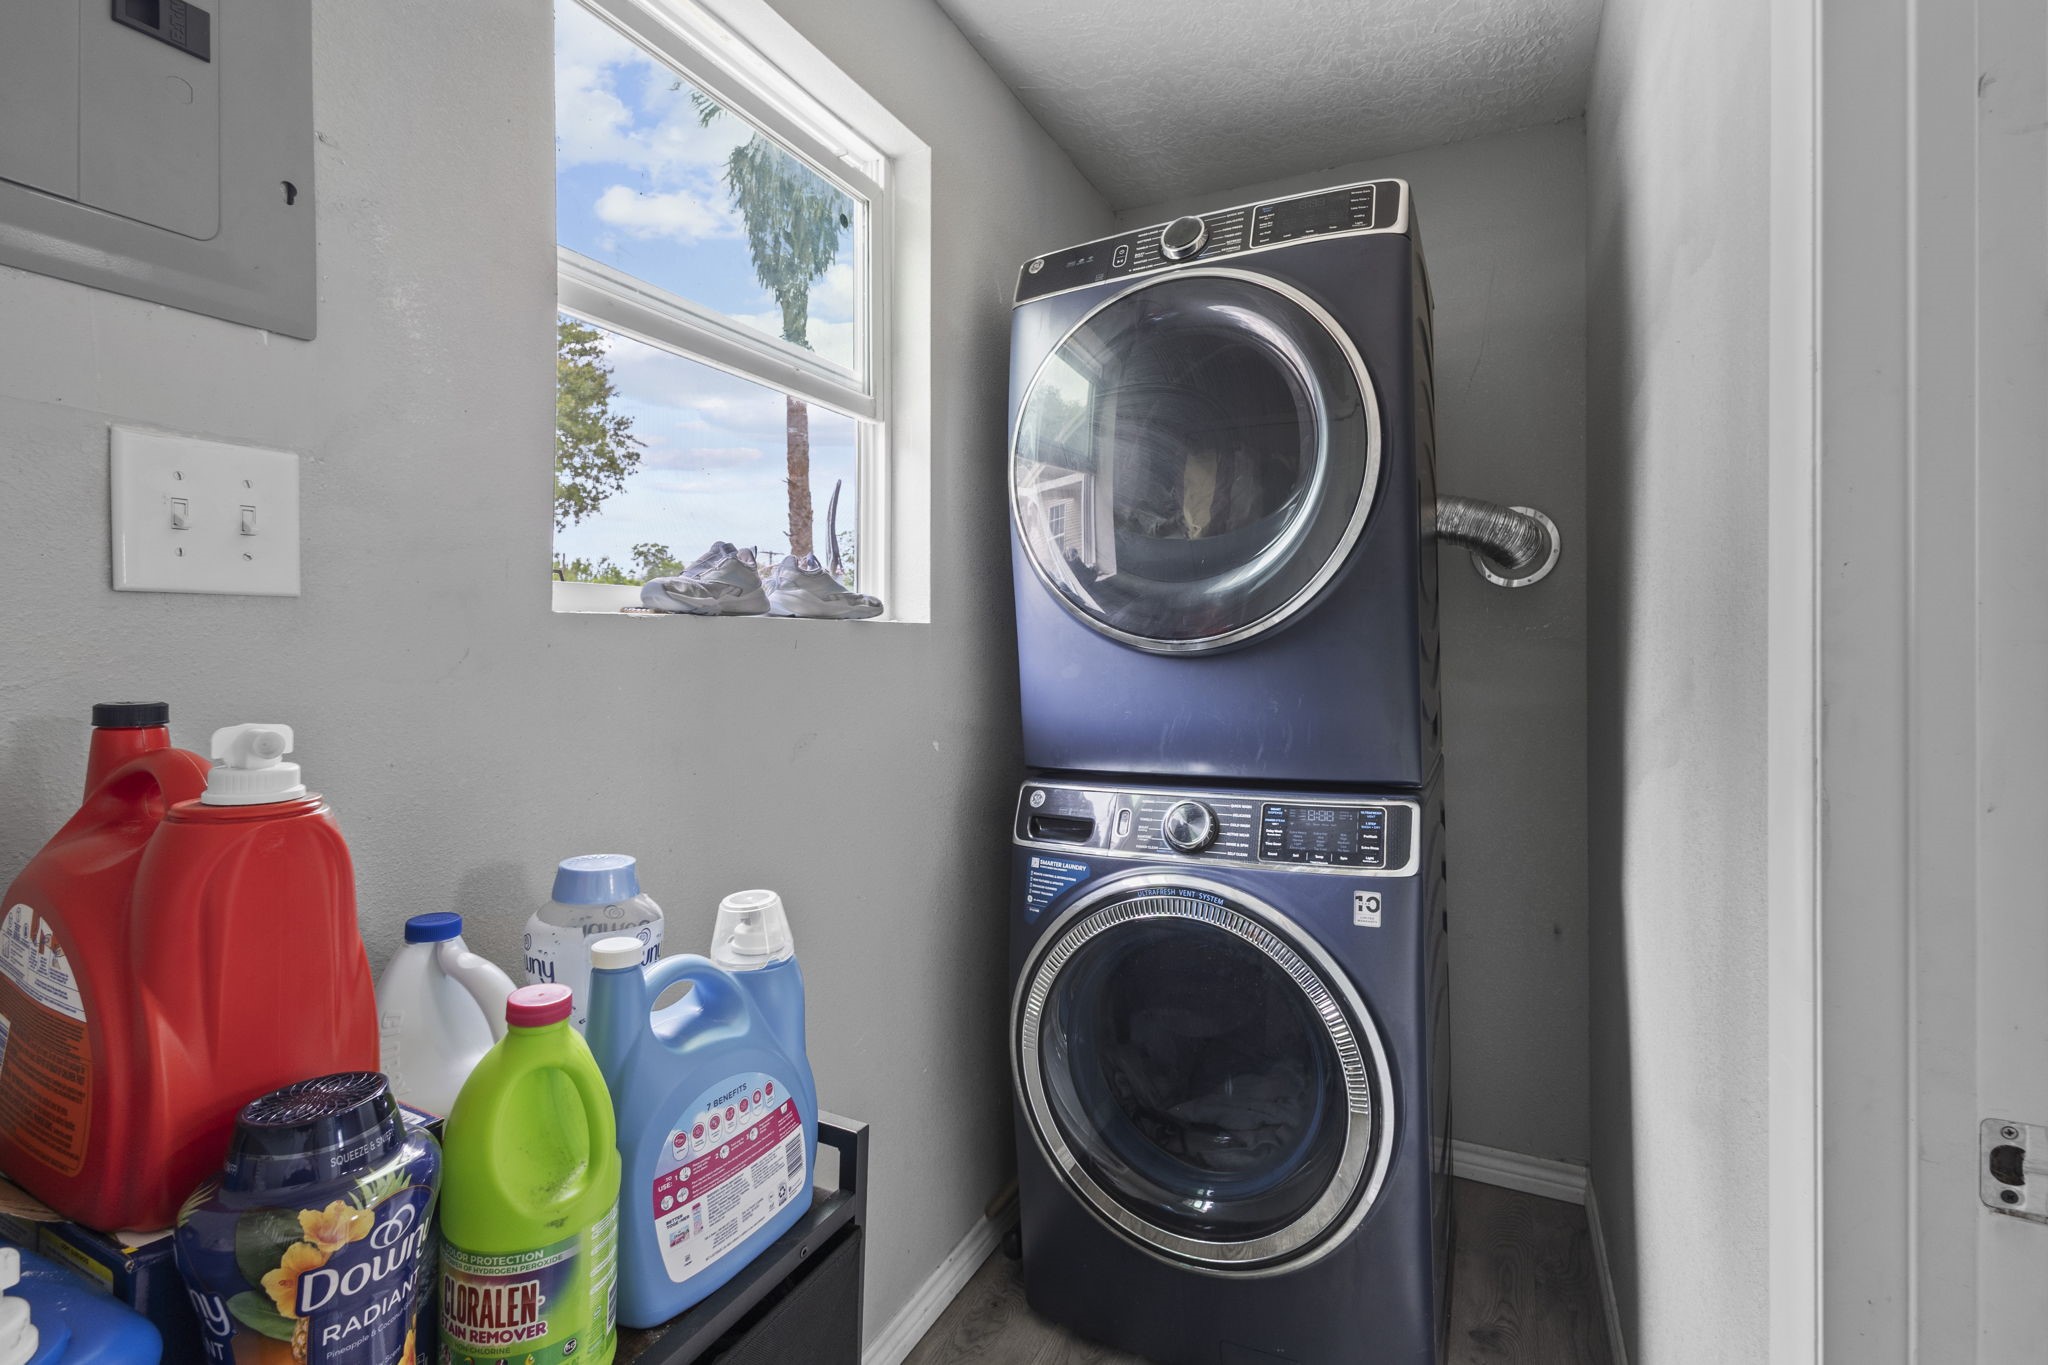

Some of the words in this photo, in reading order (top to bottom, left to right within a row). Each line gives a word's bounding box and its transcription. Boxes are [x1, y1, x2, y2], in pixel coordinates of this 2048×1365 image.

[1040, 859, 1063, 868] SMARTER
[1062, 863, 1087, 871] LAUNDRY
[1138, 888, 1175, 897] ULTRAFRESH
[1179, 889, 1195, 898] VENT
[1198, 891, 1224, 905] SYSTEM
[706, 1103, 712, 1111] 7
[713, 1083, 747, 1108] BENEFITS
[330, 1144, 369, 1168] SQUEEZE
[370, 1140, 376, 1151] &
[470, 1250, 544, 1266] PROTECTION
[473, 1266, 518, 1275] HYDROGEN
[519, 1254, 563, 1272] PEROXIDE
[322, 1265, 420, 1347] RADIANT
[444, 1275, 537, 1329] CLORALEN
[326, 1335, 369, 1360] Pineapple
[371, 1328, 376, 1337] &
[469, 1322, 547, 1344] REMOVER
